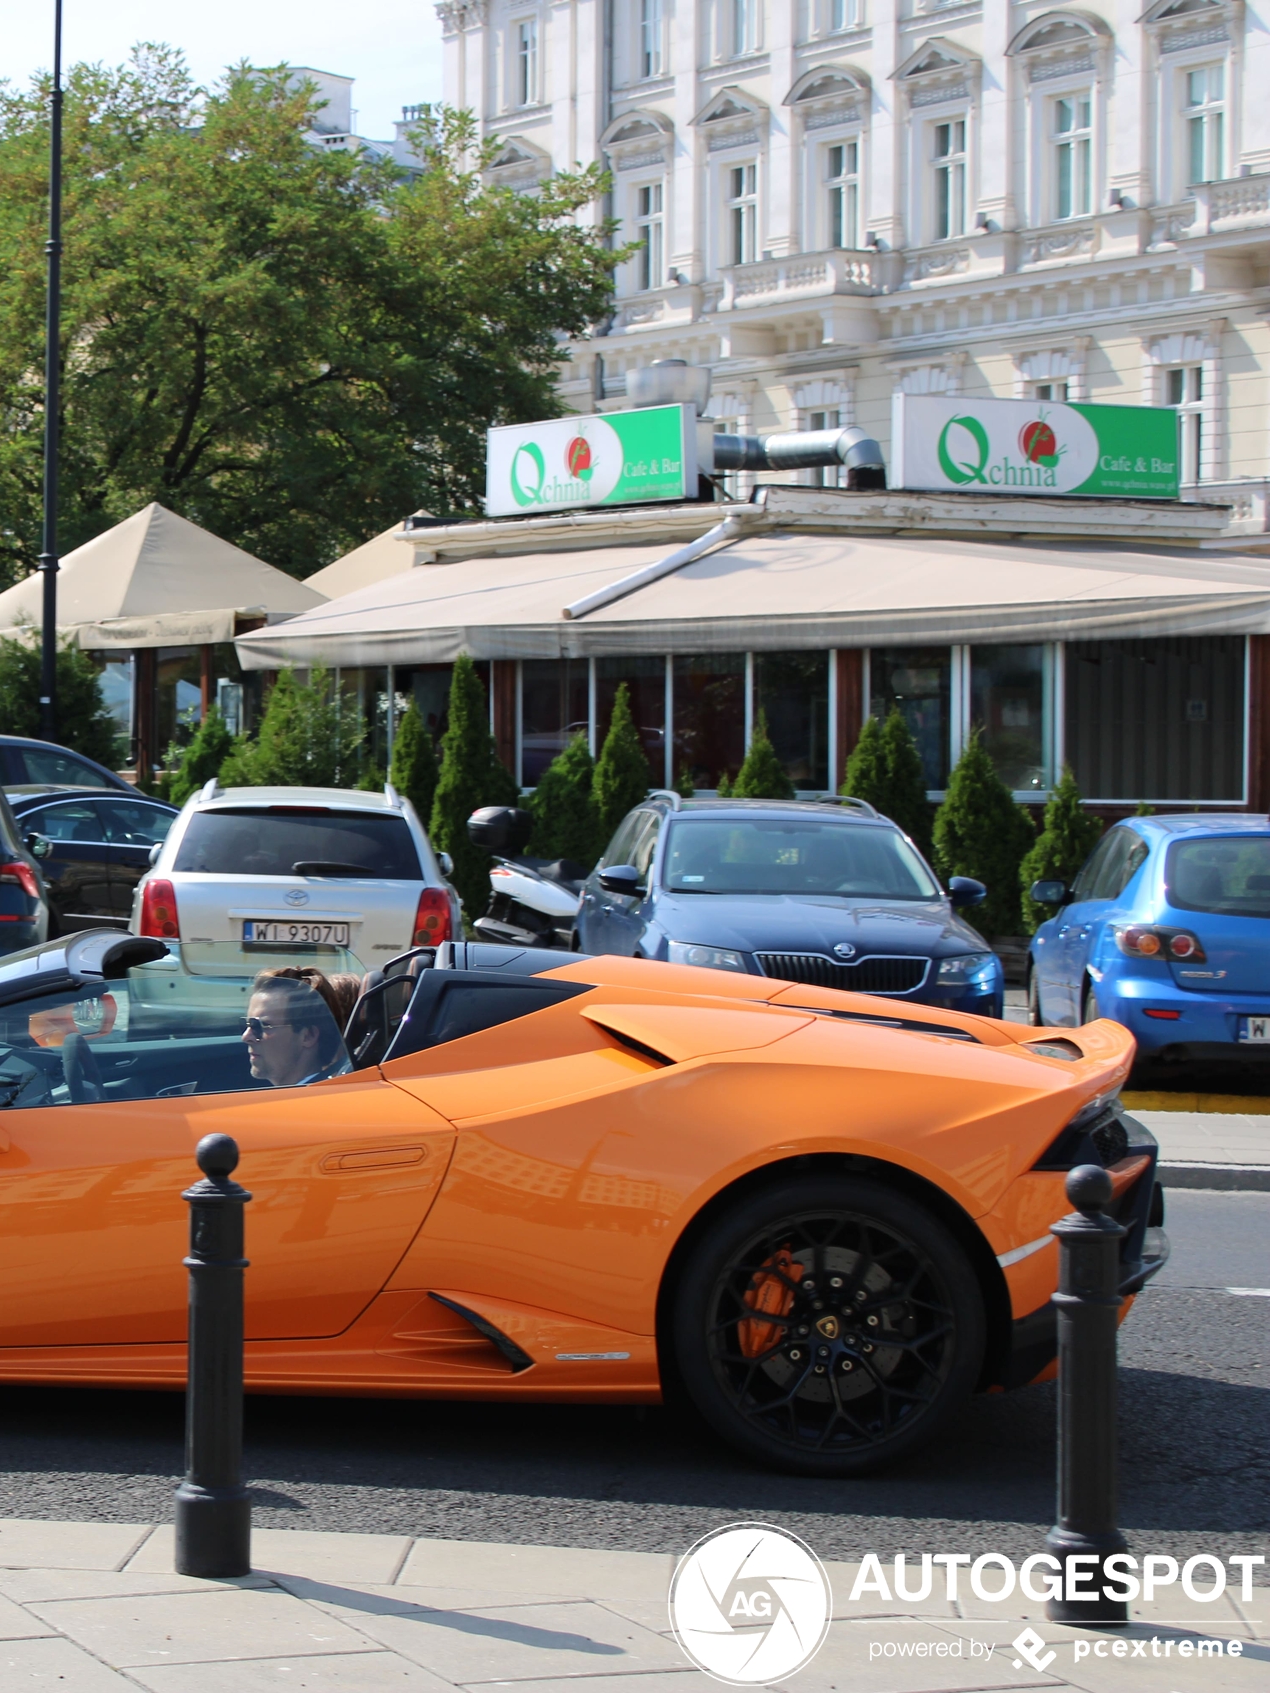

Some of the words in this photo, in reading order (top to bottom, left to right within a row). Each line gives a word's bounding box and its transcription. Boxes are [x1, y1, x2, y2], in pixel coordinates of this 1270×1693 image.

[937, 413, 1058, 487] Qchnia
[510, 442, 591, 507] Qchnia
[623, 460, 648, 478] Cafe
[649, 459, 660, 475] &
[661, 458, 681, 474] Bar
[1099, 455, 1132, 472] Cafe
[1134, 457, 1148, 473] &
[1151, 457, 1175, 474] Bar
[255, 923, 279, 941] WI
[288, 925, 346, 943] 9307U
